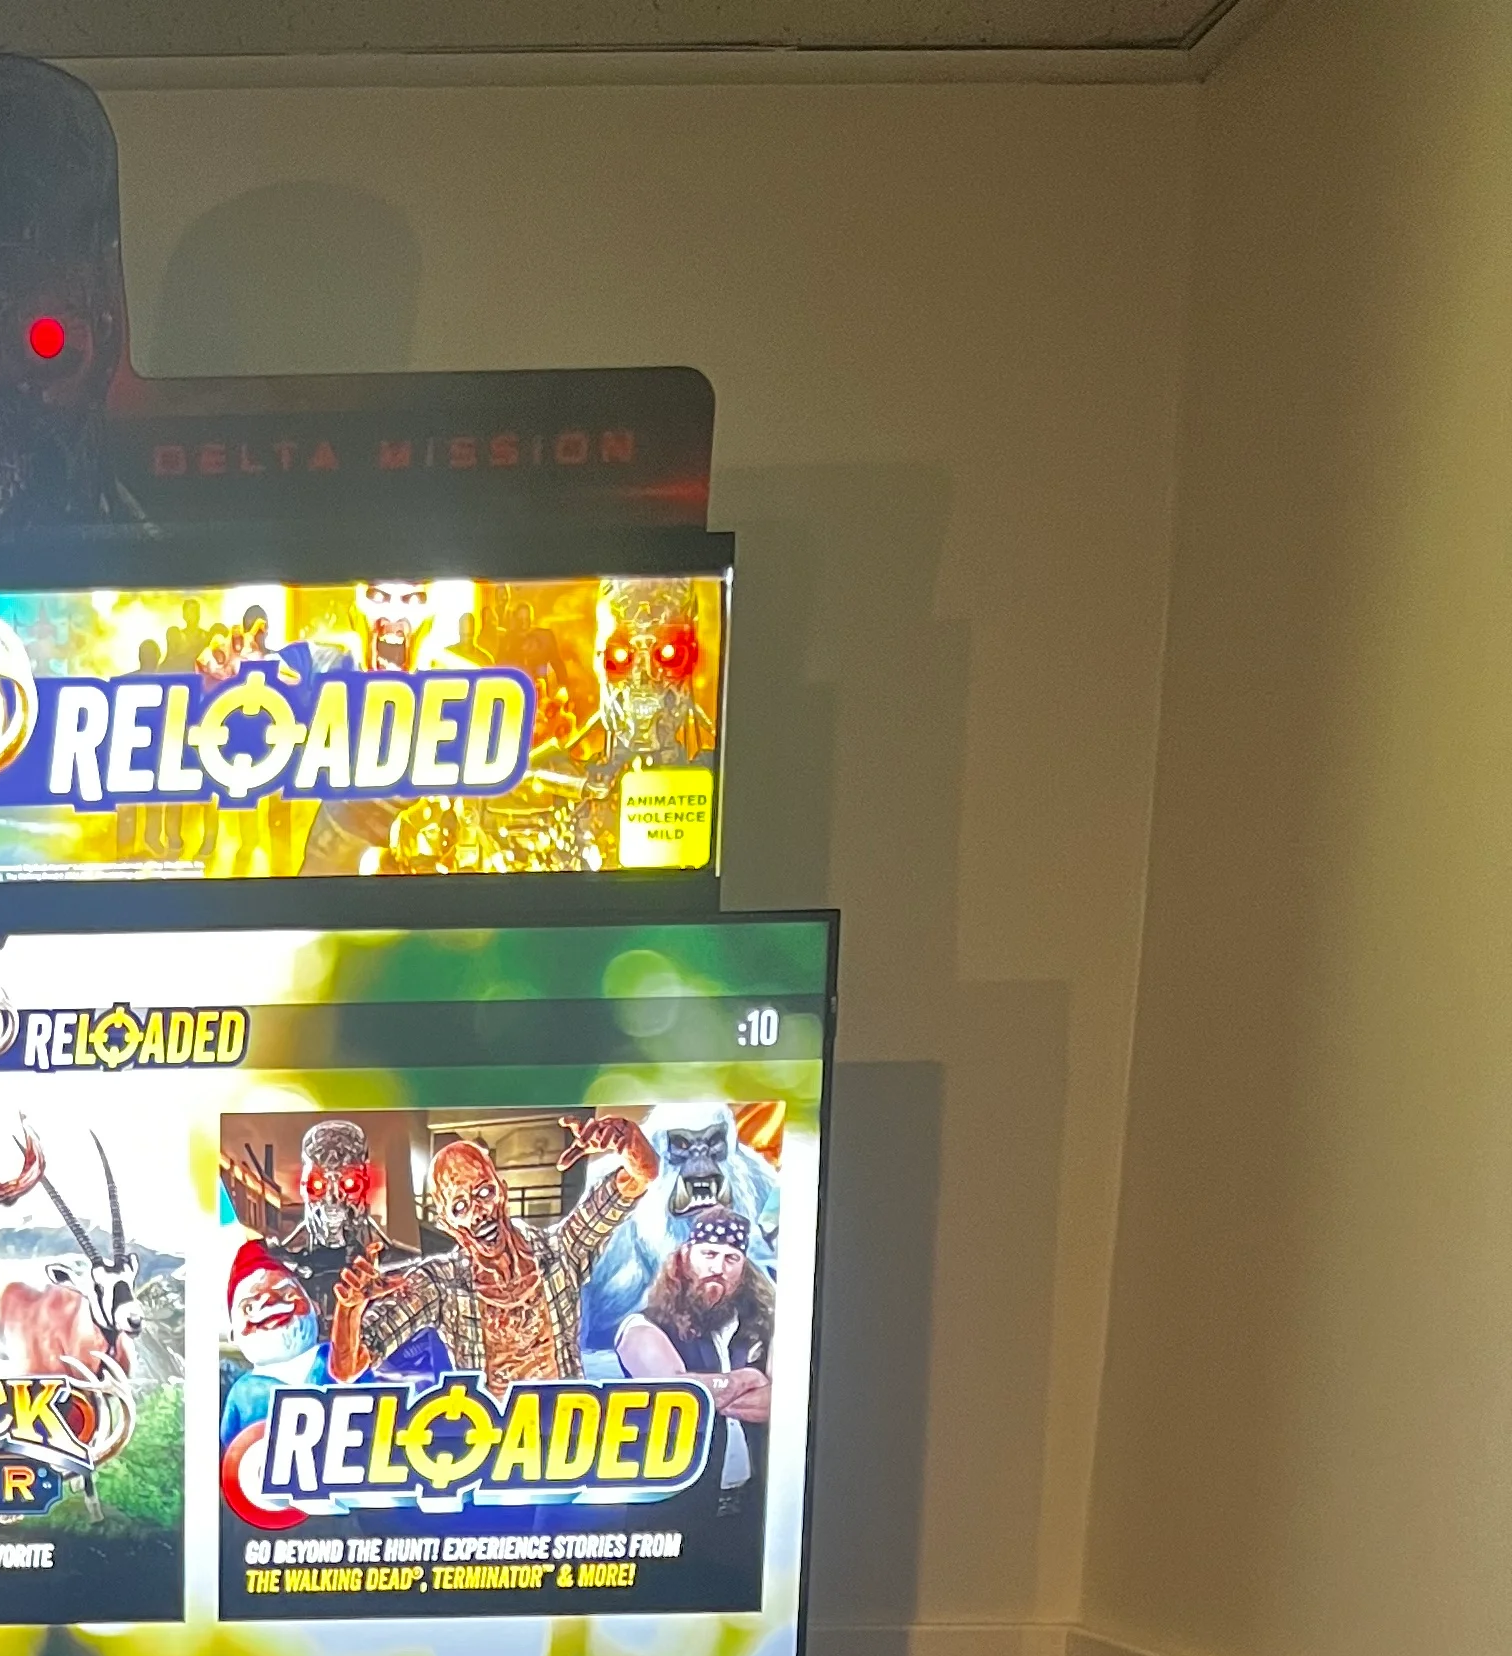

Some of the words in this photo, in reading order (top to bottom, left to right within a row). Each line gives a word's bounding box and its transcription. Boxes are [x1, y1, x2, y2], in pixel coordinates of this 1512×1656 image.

[152, 441, 340, 477] DELTA
[378, 430, 635, 470] MISSION
[48, 670, 527, 801] RELOADED
[627, 795, 707, 807] ANIMATED
[627, 812, 705, 824] VIOLENCE
[647, 829, 684, 841] MILD
[23, 1006, 245, 1069] RELOADED
[738, 1009, 779, 1046] :10
[270, 1385, 702, 1492] RELOADED
[246, 1540, 270, 1565] GO
[274, 1539, 345, 1564] BEYOND
[347, 1538, 384, 1563] THE
[387, 1537, 440, 1563] HUNT!
[444, 1535, 552, 1562] EXPERIENCE
[554, 1535, 626, 1560] STORIES
[629, 1533, 682, 1558] FROM
[246, 1569, 280, 1593] THE
[284, 1567, 363, 1592] WALKING
[557, 1564, 573, 1588] &
[577, 1562, 637, 1588] MORE!
